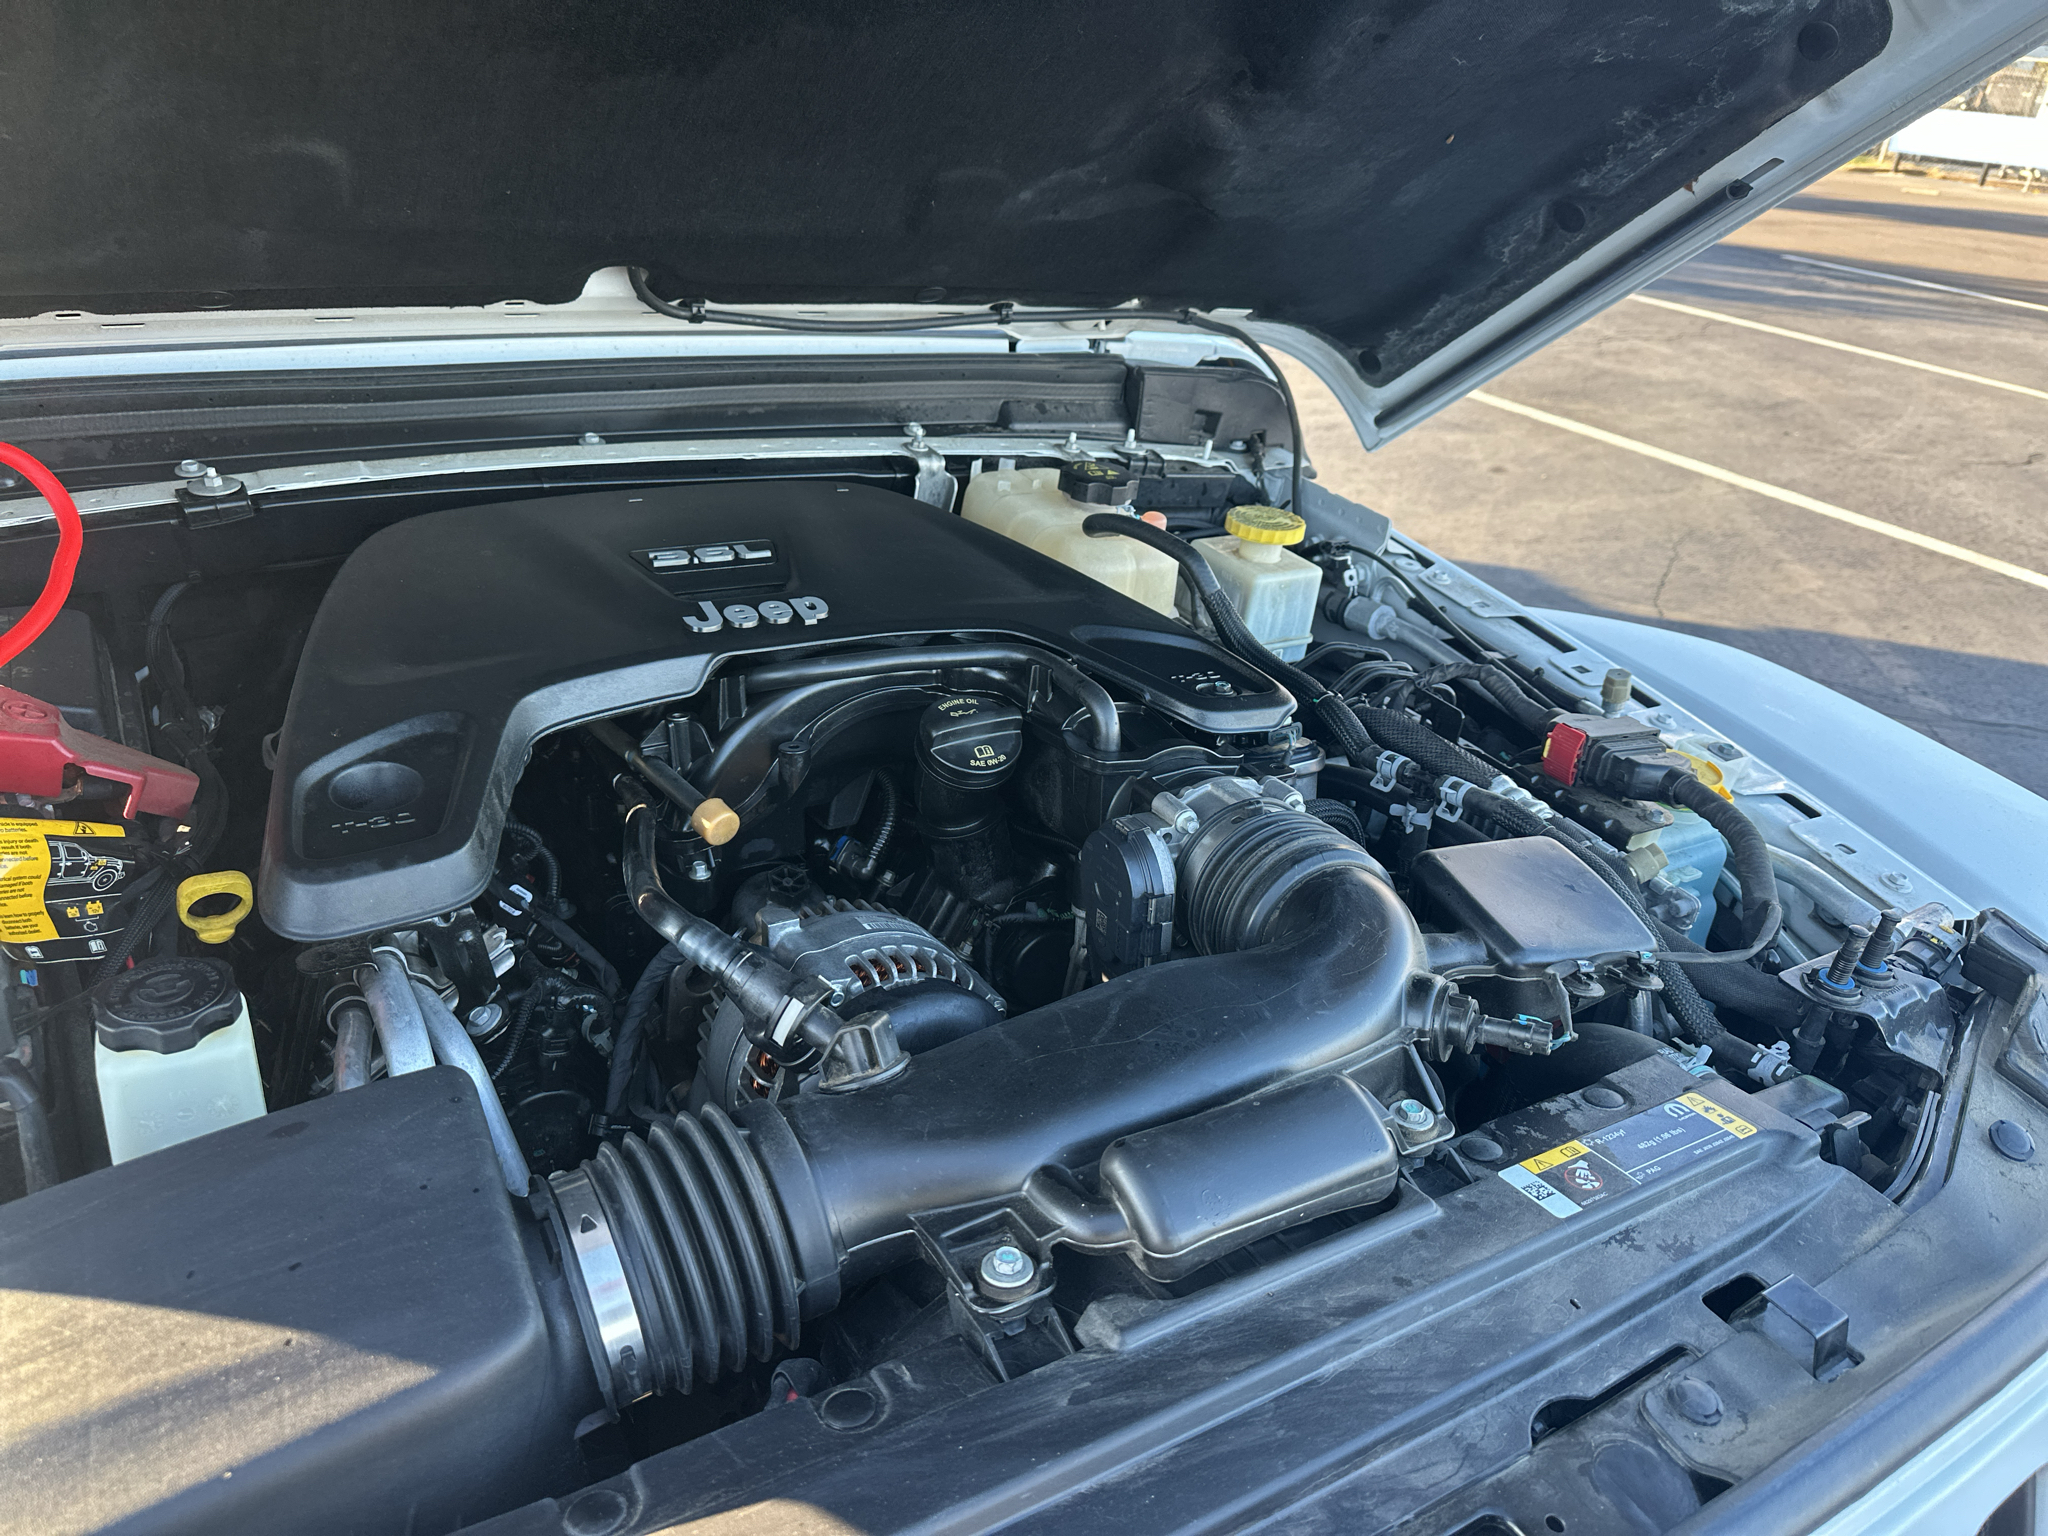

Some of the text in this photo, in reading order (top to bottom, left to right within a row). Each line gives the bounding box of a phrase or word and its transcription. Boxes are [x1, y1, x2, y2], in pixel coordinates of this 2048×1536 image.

[682, 596, 829, 633] Jeep
[938, 698, 965, 711] ENGINE
[970, 759, 986, 767] SAE
[1645, 1165, 1662, 1175] PAG
